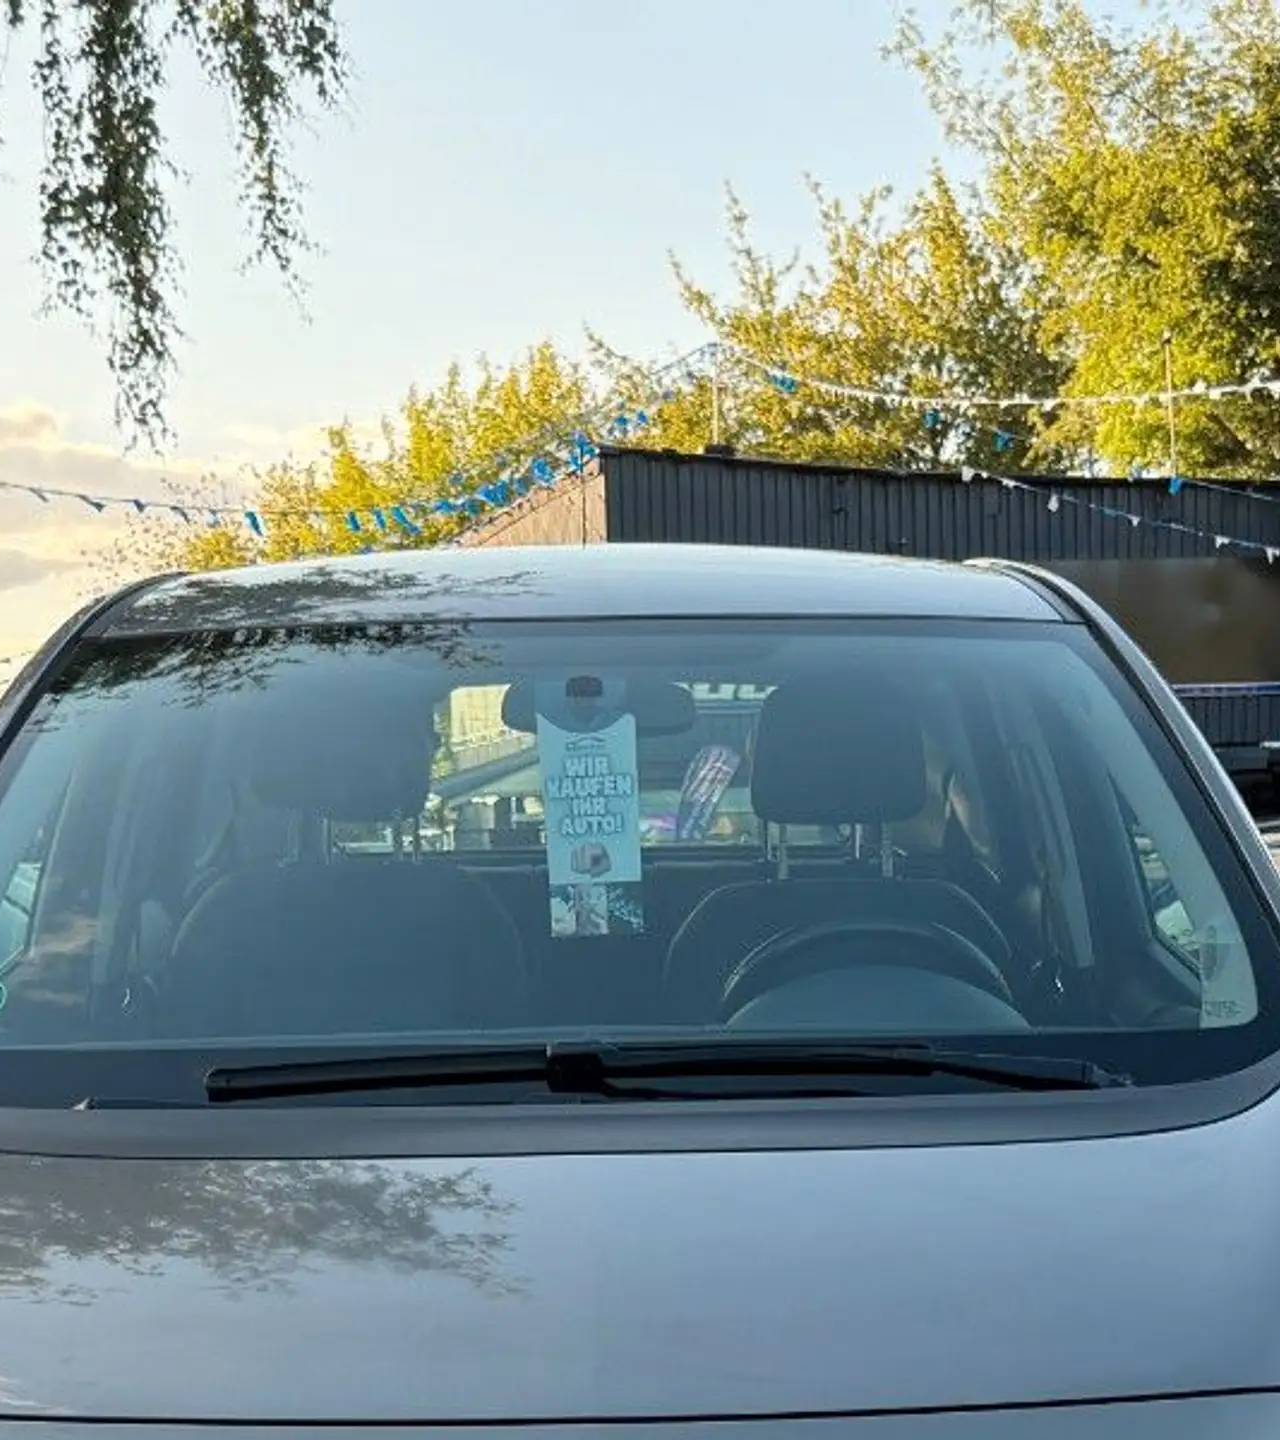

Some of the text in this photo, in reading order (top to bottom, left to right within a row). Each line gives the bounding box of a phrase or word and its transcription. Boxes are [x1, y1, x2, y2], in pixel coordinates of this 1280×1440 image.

[563, 754, 609, 777] WIR
[546, 773, 632, 799] KAUFEN
[571, 796, 607, 816] IHR
[560, 812, 624, 836] AUTO!
